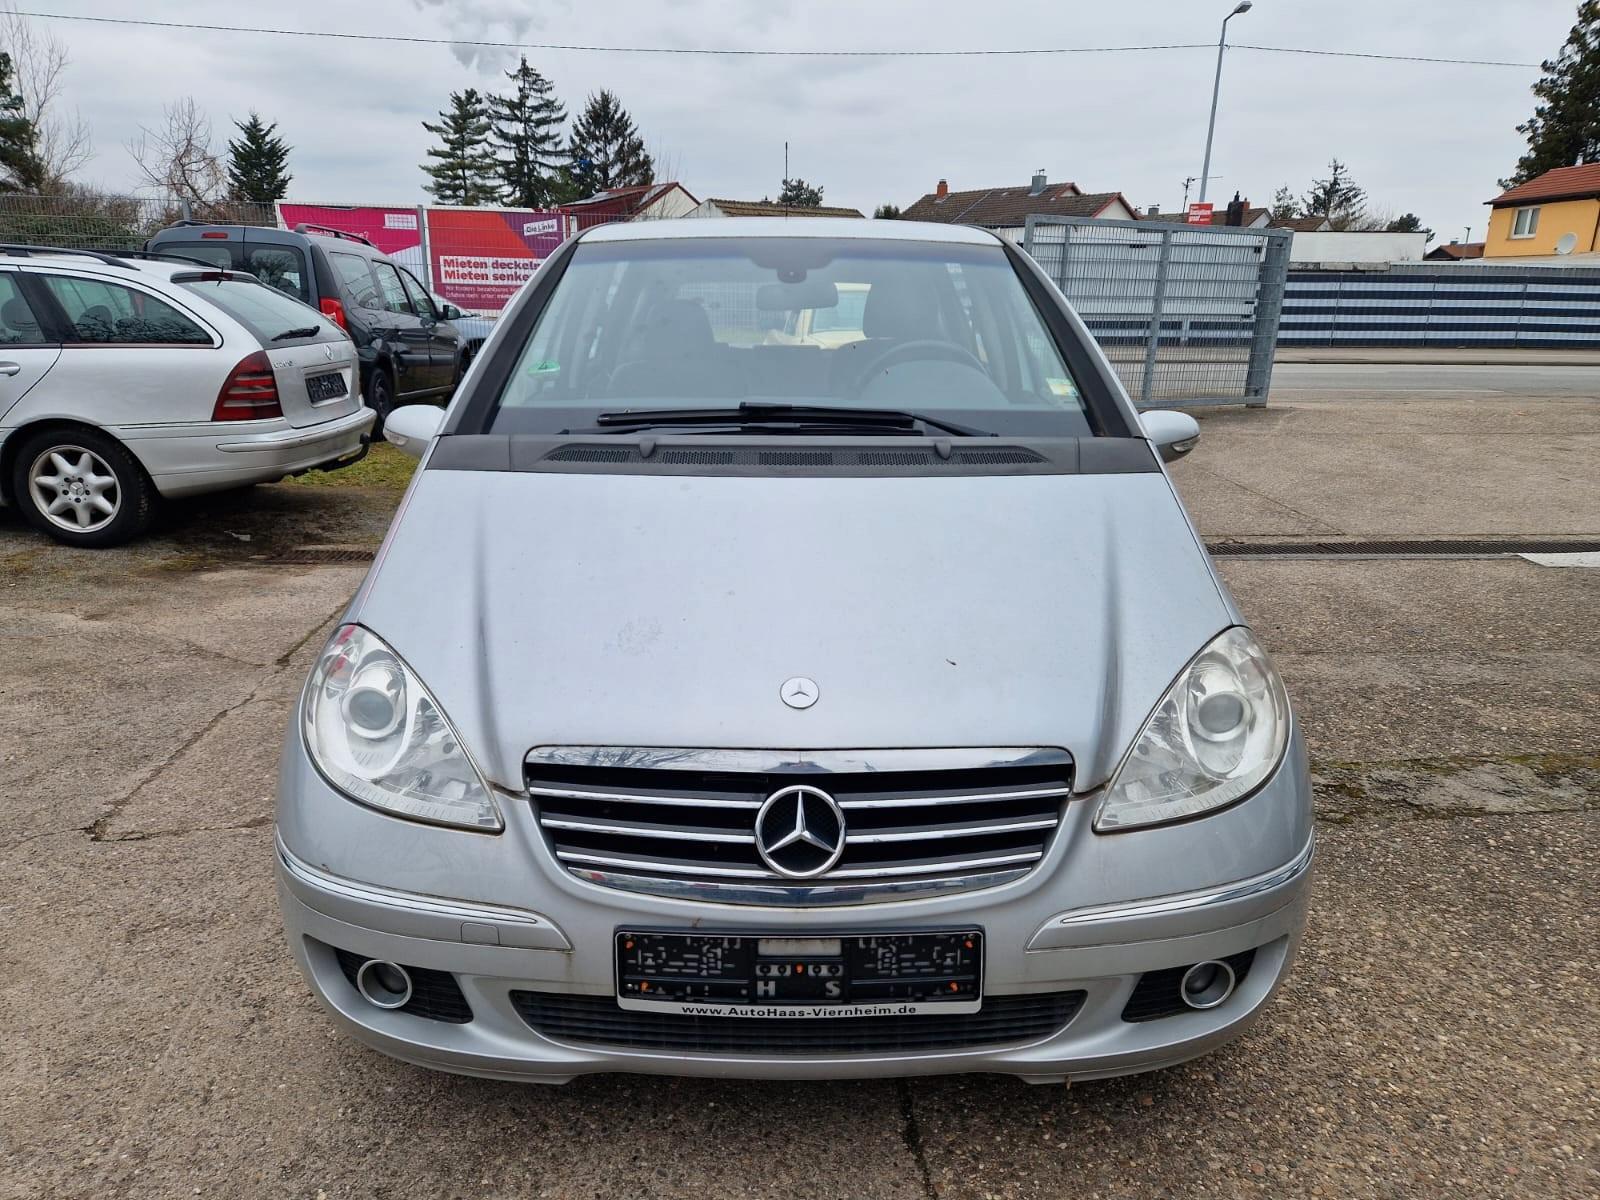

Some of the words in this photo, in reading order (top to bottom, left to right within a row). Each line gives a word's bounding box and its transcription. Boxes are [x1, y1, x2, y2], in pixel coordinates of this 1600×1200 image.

[526, 225, 537, 233] Die
[538, 222, 555, 232] Linke
[443, 258, 488, 269] Mieten
[444, 269, 489, 281] Mieten
[492, 271, 532, 282] senke
[681, 1004, 917, 1018] www.AutoHaas-Viernheim.de
